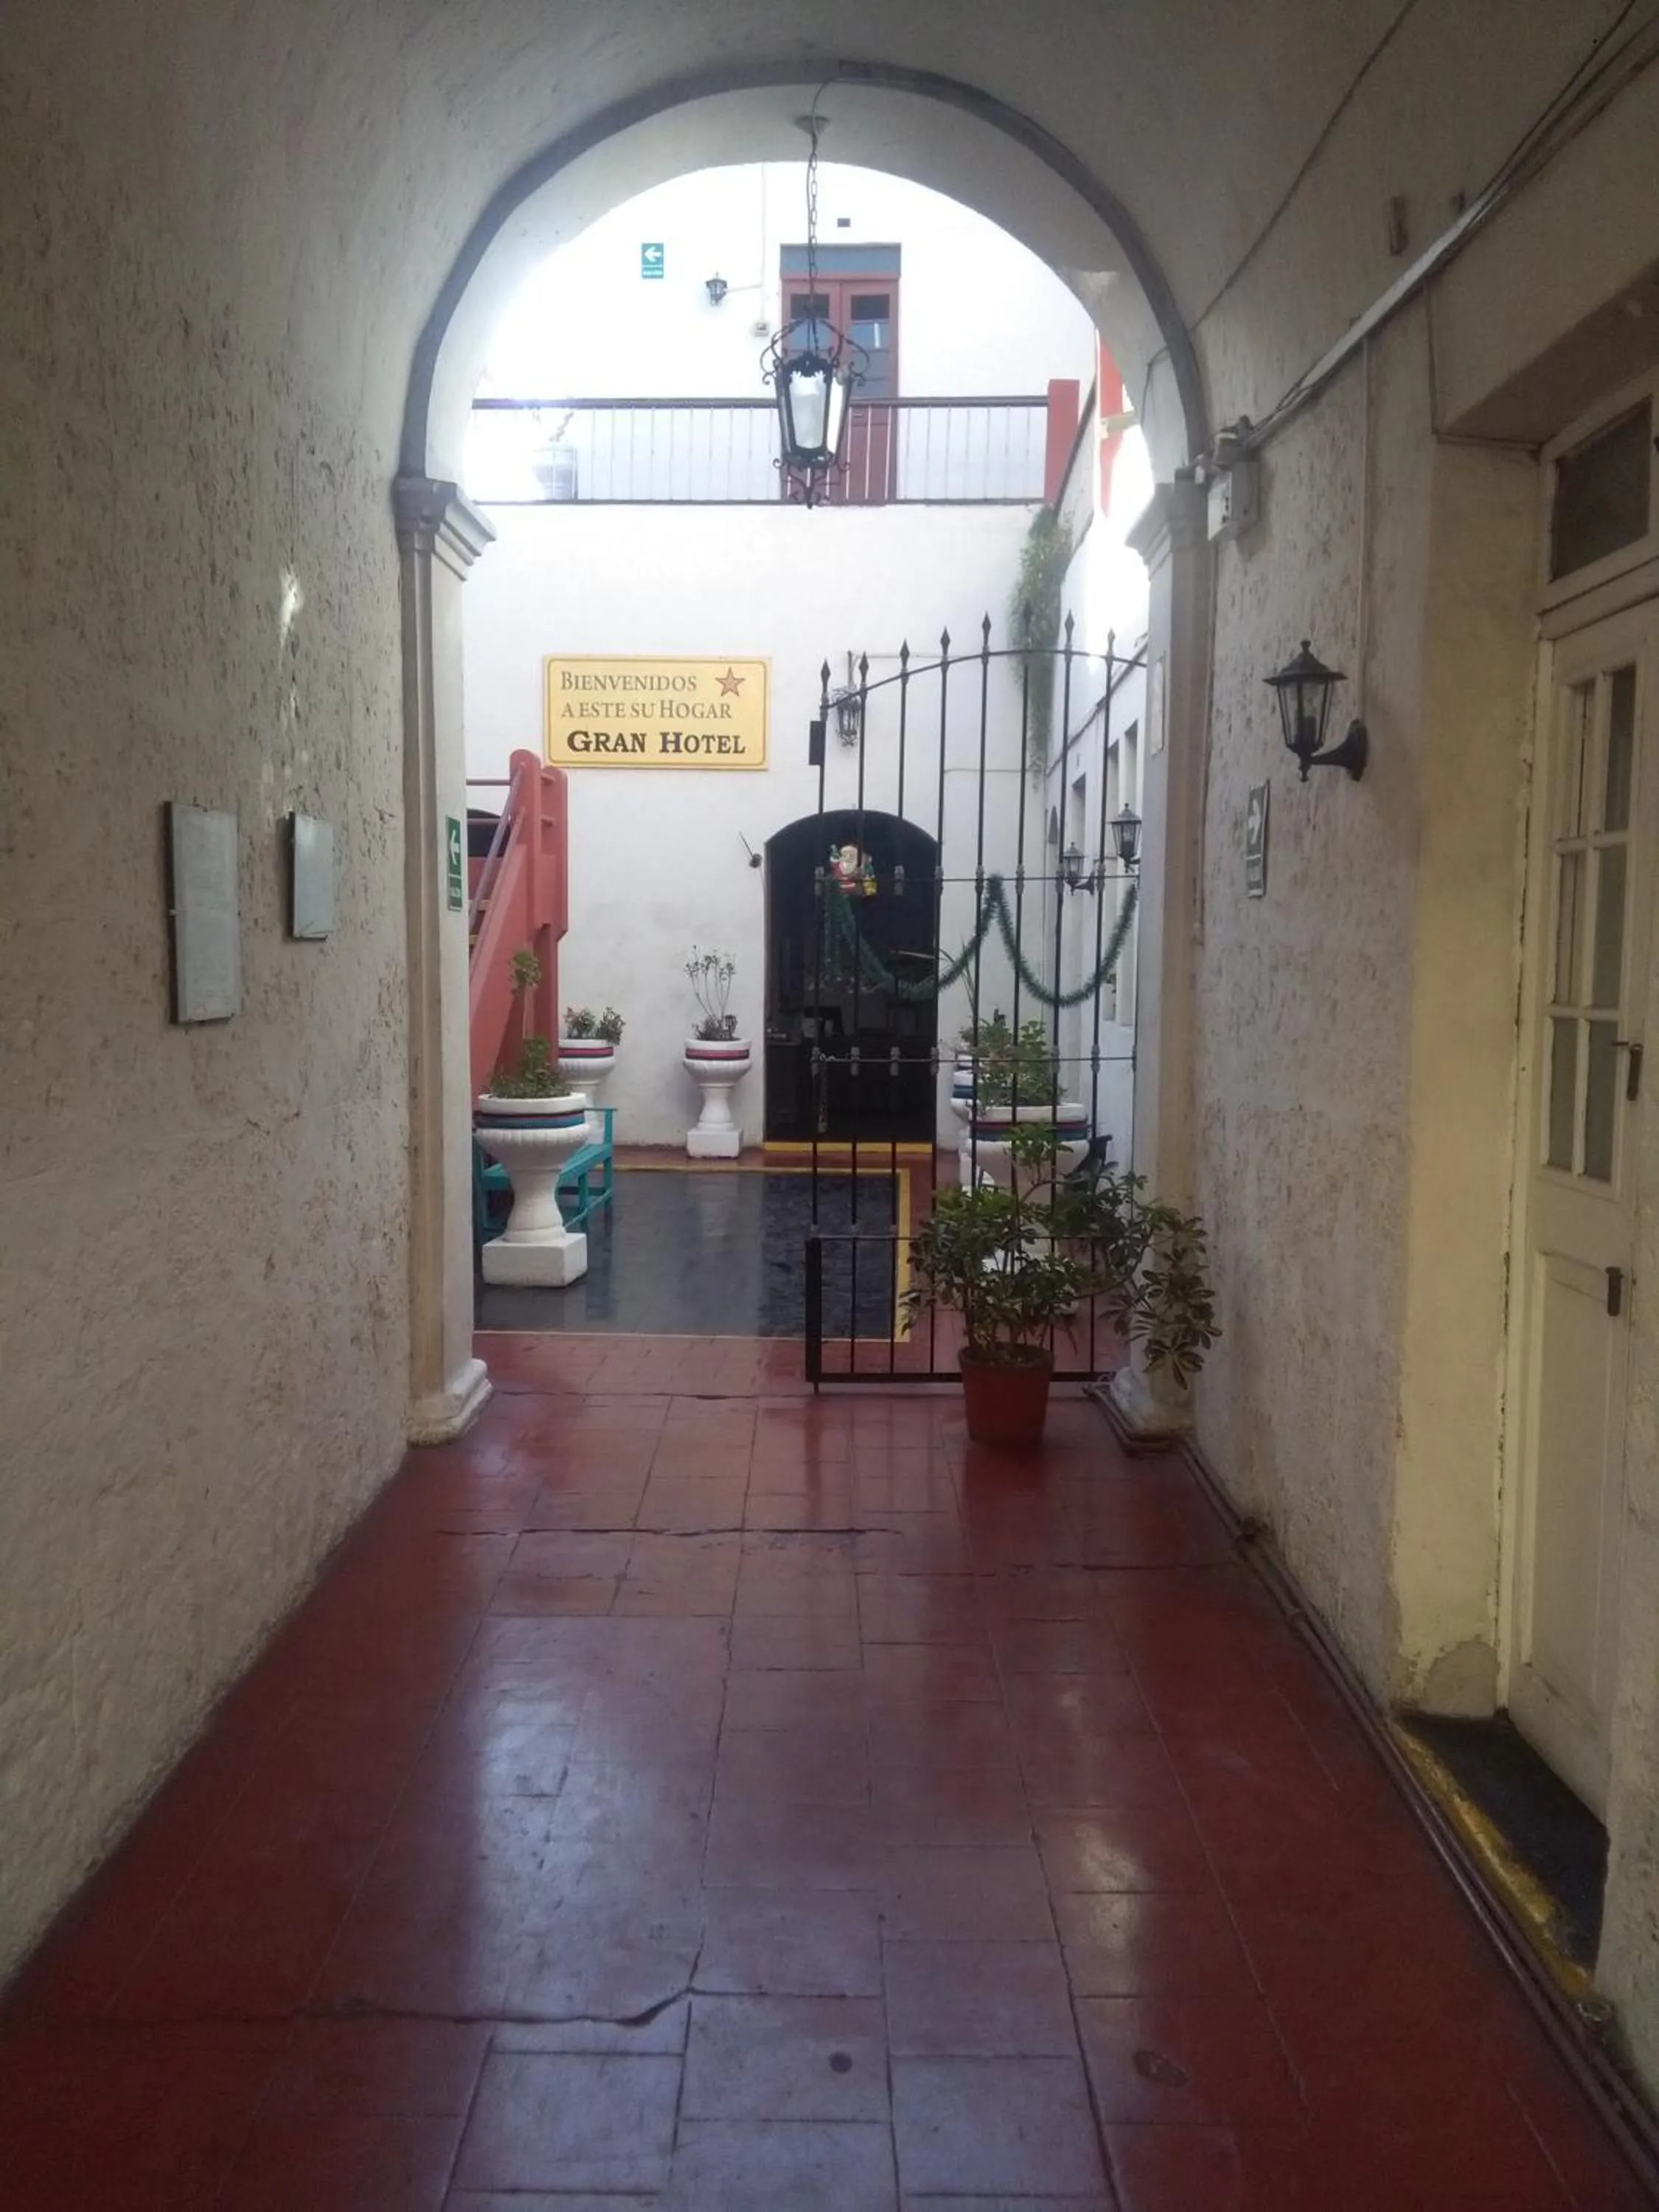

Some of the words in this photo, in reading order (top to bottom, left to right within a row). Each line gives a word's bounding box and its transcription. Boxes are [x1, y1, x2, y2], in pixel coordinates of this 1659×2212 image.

[561, 671, 698, 692] BIENVENIDOS
[561, 703, 574, 718] A
[579, 703, 627, 718] ESTE
[630, 702, 655, 719] SU
[660, 700, 733, 720] HOGAR
[567, 730, 647, 752] GRAN
[659, 731, 746, 754] HOTEL
